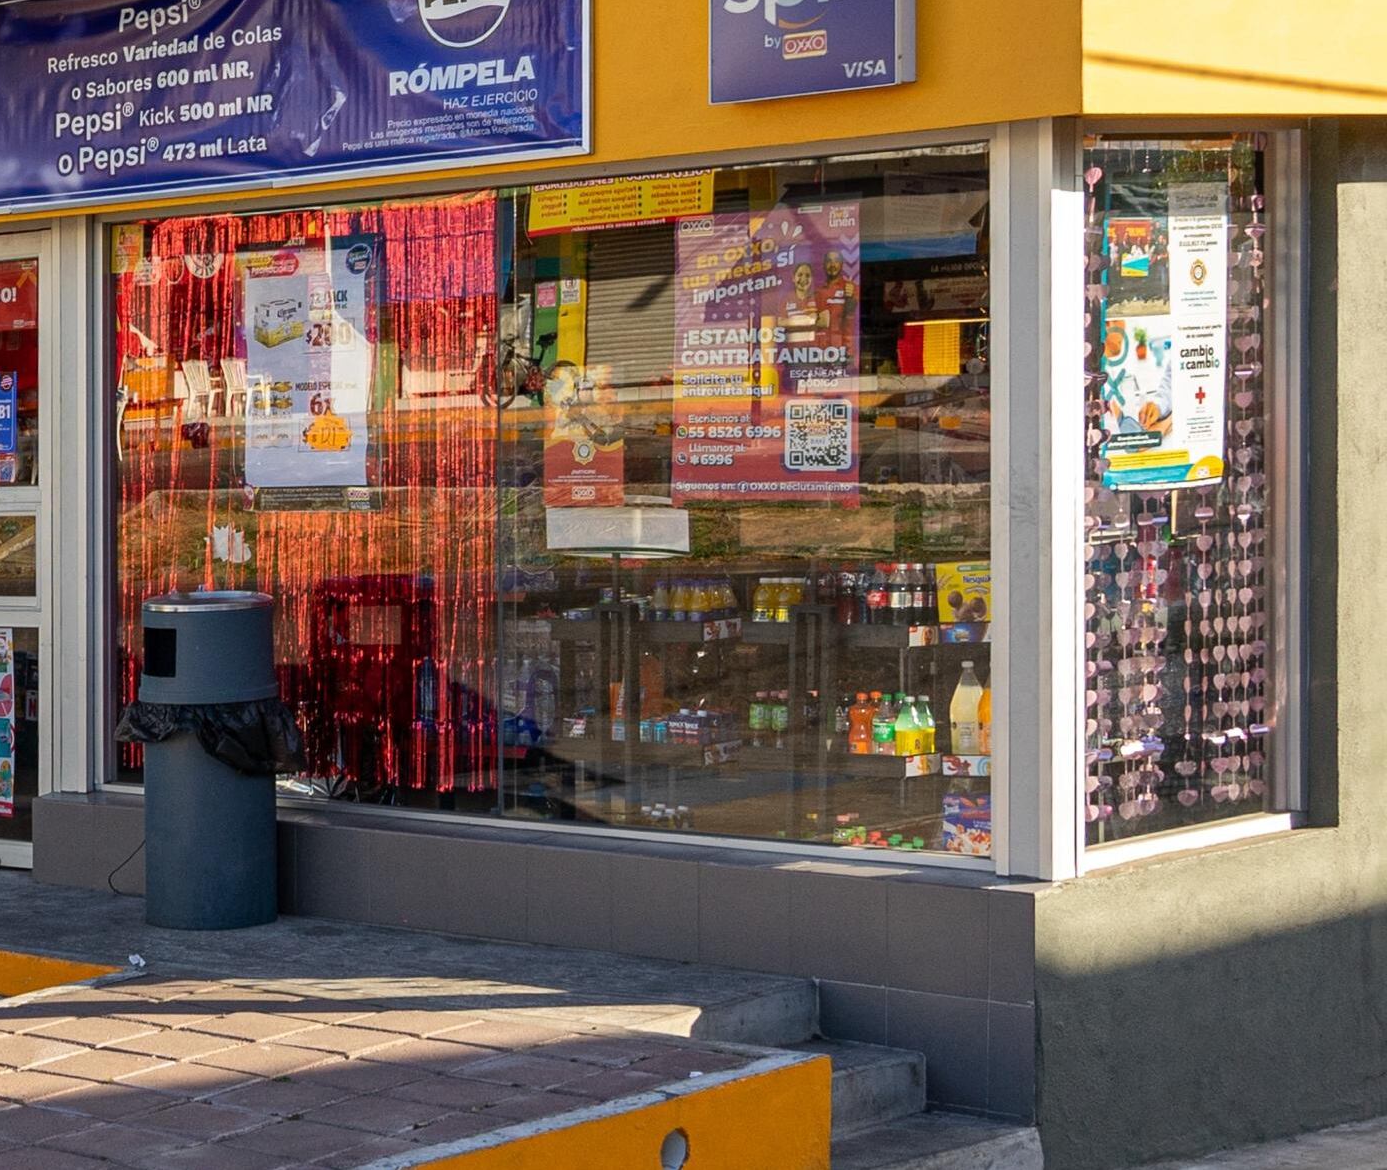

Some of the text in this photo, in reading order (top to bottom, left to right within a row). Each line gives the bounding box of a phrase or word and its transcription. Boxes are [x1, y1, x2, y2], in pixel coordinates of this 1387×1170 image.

[48, 26, 283, 74] Refresco Variedad de Colas
[764, 35, 825, 55] by OXXO
[389, 55, 536, 97] RÓMPELA
[842, 59, 887, 79] VISA
[71, 60, 254, 100] o Sabores 600 ml NR,
[443, 88, 538, 110] HAZ EJERCICIO
[138, 106, 176, 127] Kick
[179, 102, 215, 122] 500
[218, 97, 243, 118] ml
[246, 94, 273, 114] NR
[387, 119, 412, 128] Precio
[413, 114, 453, 127] expresado
[466, 109, 499, 119] moneda
[57, 153, 73, 174] o
[162, 143, 196, 162] 473
[199, 138, 223, 158] ml
[227, 135, 268, 155] Lata
[342, 141, 363, 152] Pepsi
[681, 220, 713, 232] OXXO
[683, 244, 795, 290] tus metas sí
[696, 254, 719, 269] En
[693, 274, 782, 305] importan.
[683, 327, 787, 348] ¡ESTAMOS
[681, 346, 847, 366] CONTRATANDO!
[1186, 356, 1220, 370] cambio
[682, 374, 743, 385] Solicita tu
[682, 383, 773, 398] entrevista aquí
[688, 413, 739, 424] Escríbenos
[688, 426, 781, 439] 55 8526 6996
[689, 443, 734, 454] Llámanos
[750, 482, 776, 491] OXXO
[779, 481, 852, 492] Reclutamiento
